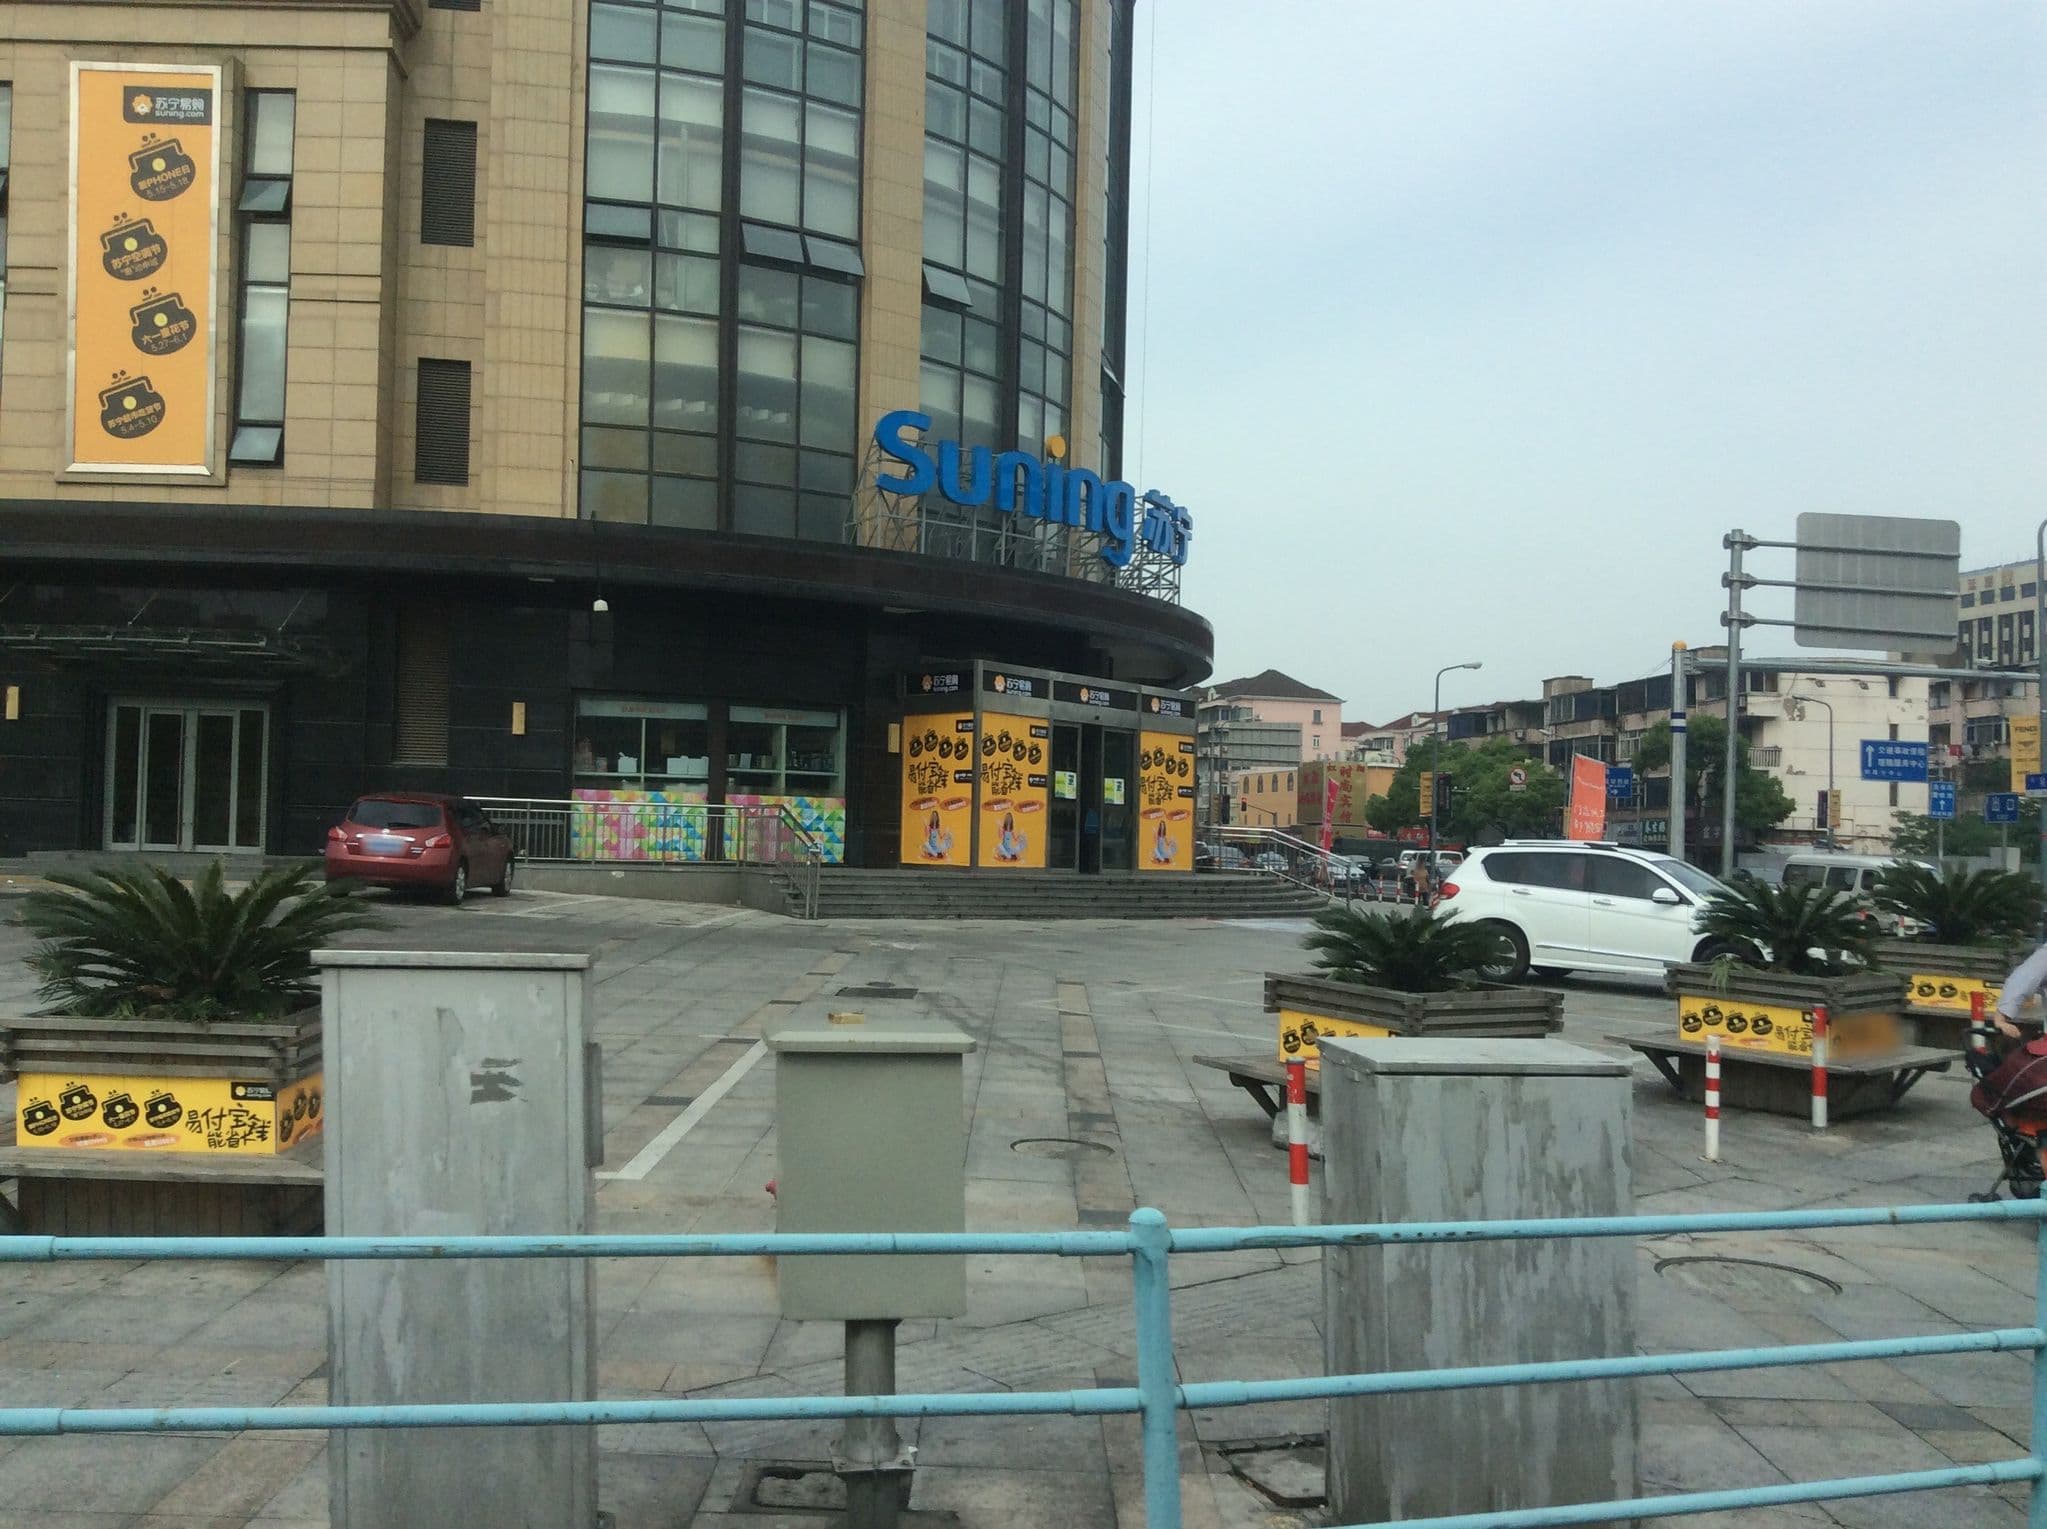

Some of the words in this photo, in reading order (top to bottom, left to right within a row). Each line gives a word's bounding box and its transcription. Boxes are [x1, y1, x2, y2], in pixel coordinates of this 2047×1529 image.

[155, 97, 204, 111] 苏宁易购
[155, 110, 204, 119] suning.com
[875, 409, 1136, 568] Suning
[185, 1103, 250, 1134] 易付宝
